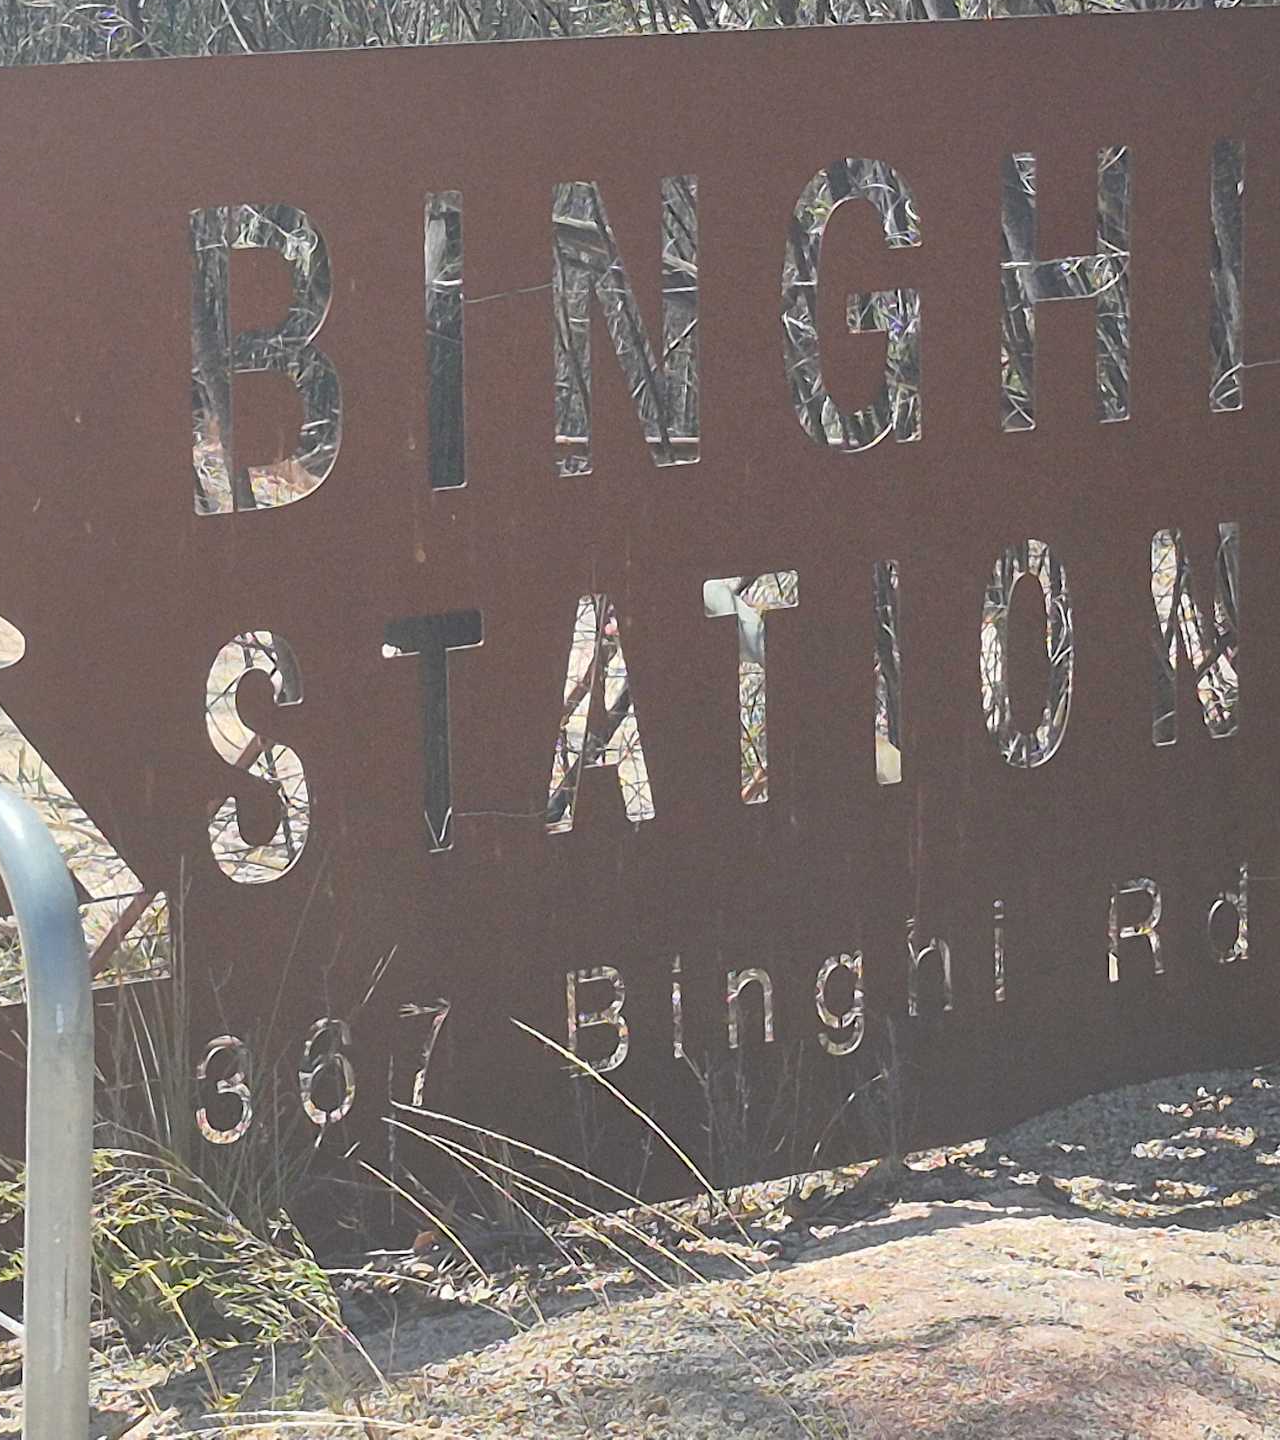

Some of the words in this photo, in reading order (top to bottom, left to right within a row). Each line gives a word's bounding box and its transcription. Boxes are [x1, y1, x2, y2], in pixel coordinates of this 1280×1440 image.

[188, 138, 1246, 515] BINGHI
[204, 521, 1240, 884] STATION
[195, 997, 452, 1145] 367
[563, 897, 1007, 1077] Binghi
[1107, 863, 1250, 983] Rd
